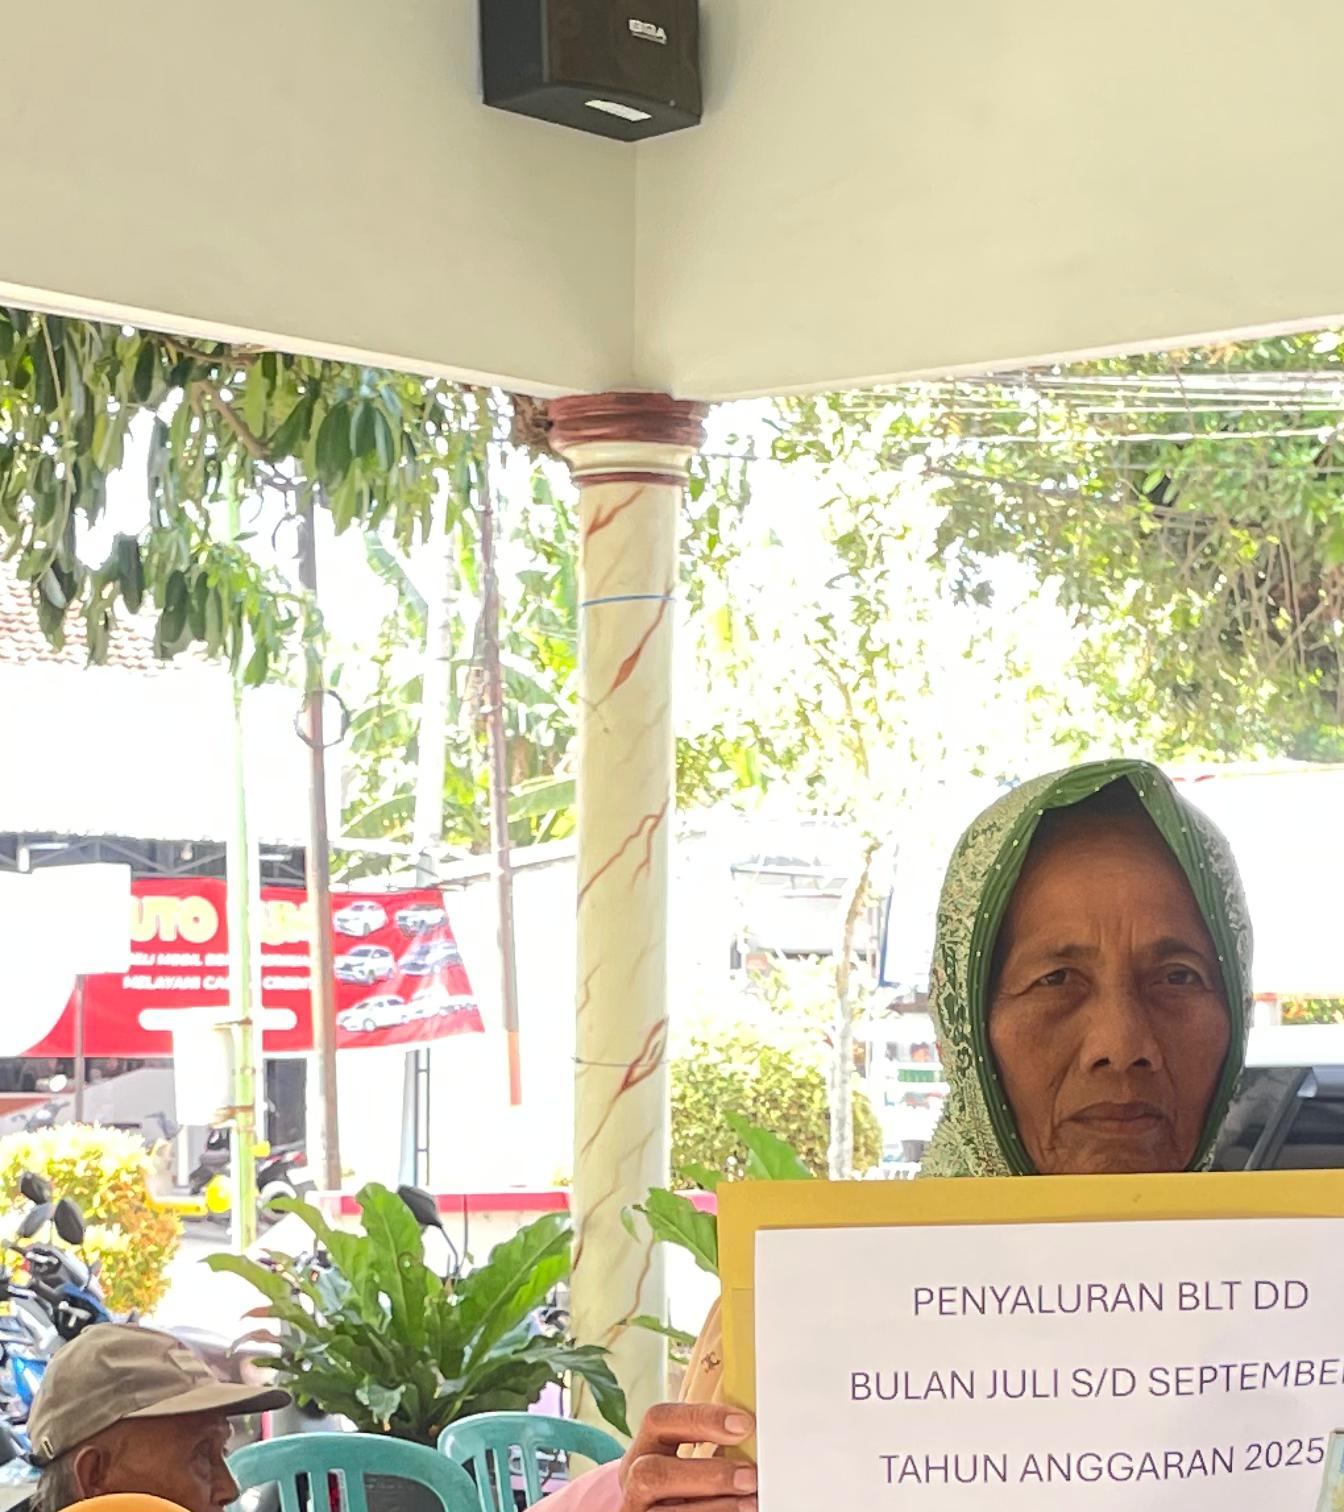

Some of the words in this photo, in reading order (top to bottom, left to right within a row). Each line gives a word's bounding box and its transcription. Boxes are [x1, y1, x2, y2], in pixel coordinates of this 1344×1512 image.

[130, 895, 219, 944] UTO
[914, 1284, 1163, 1316] PENYALURAN
[1178, 1281, 1241, 1311] BLT
[1254, 1280, 1308, 1310] DD
[851, 1370, 975, 1401] BULAN
[987, 1369, 1058, 1399] JULI
[1072, 1367, 1136, 1399] S/D
[880, 1454, 1007, 1483] TAHUN
[1019, 1446, 1234, 1482] ANGGARAN
[1244, 1437, 1325, 1472] 2025
